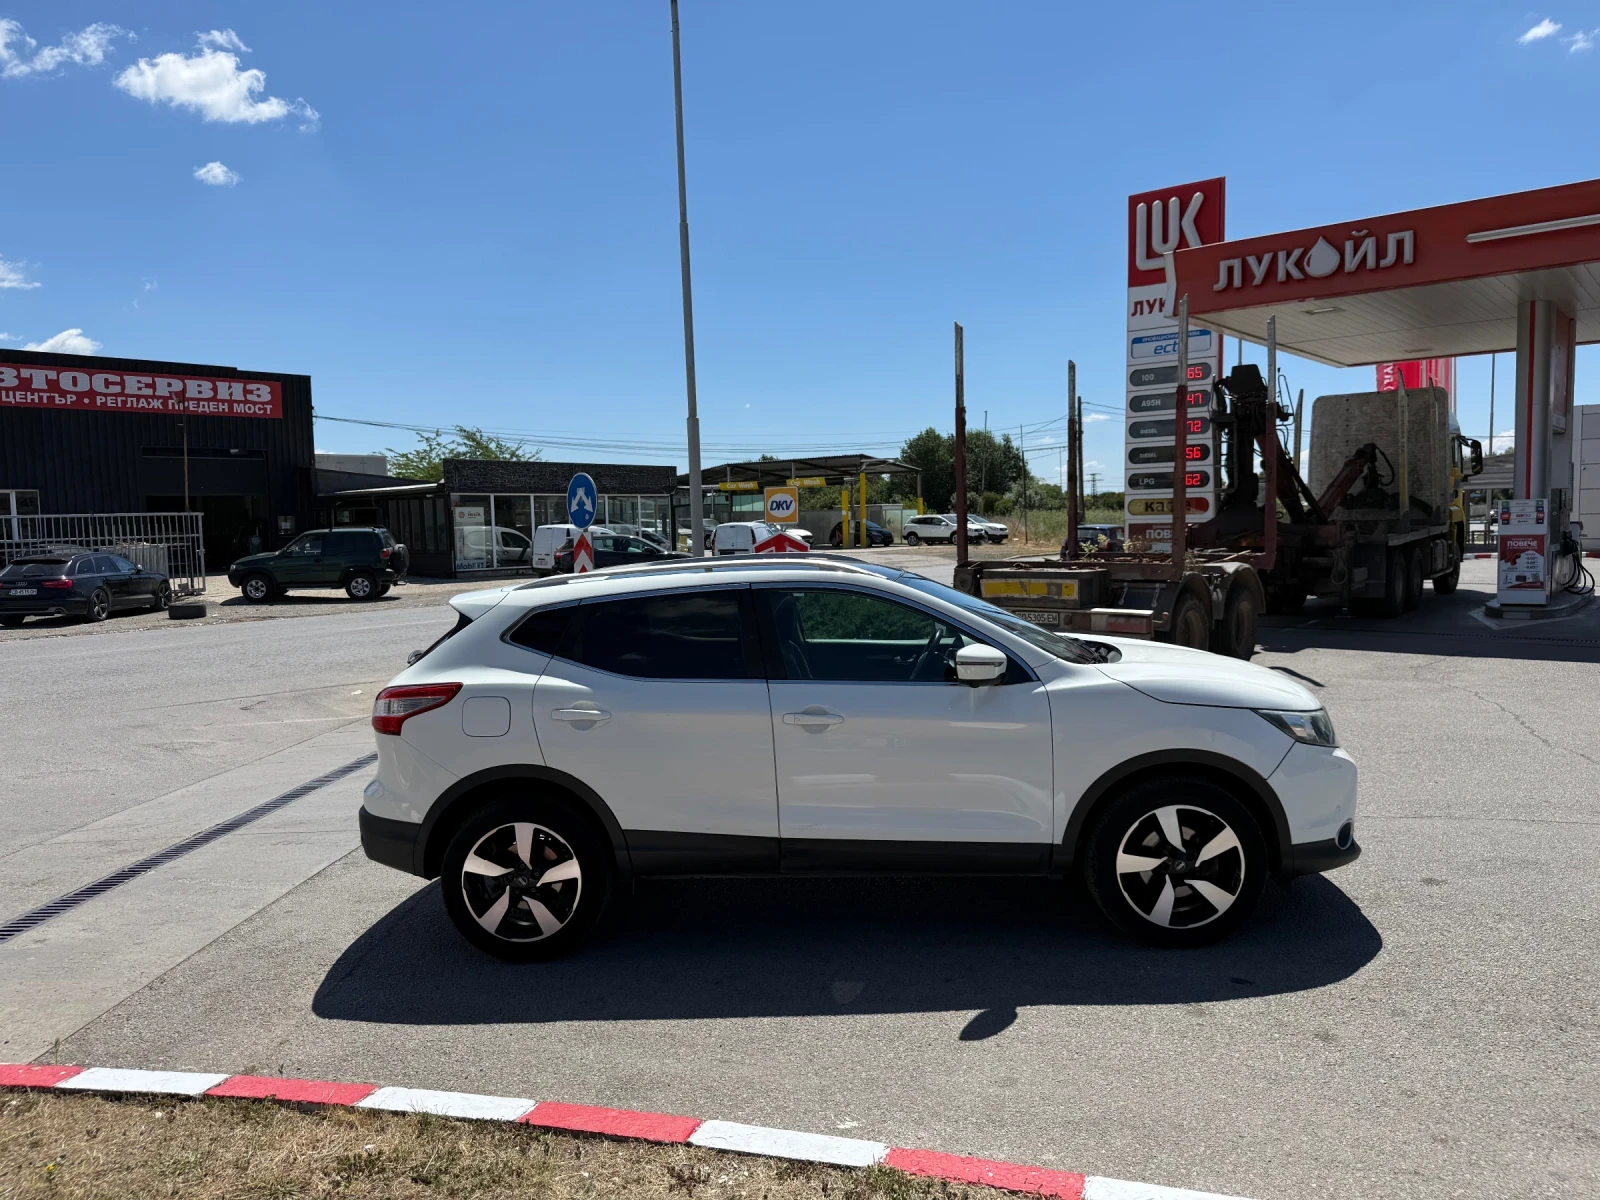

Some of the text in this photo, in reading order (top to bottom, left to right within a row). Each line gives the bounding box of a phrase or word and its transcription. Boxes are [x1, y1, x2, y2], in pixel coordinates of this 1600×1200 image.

[1131, 298, 1165, 317] ЛУК
[1154, 340, 1178, 355] ect
[1141, 374, 1154, 382] 100
[1, 390, 272, 415] ЦЕНТЪР РЕГЛАЖ ПРЕДЕН МОСТ
[1139, 477, 1155, 485] LPG
[770, 500, 793, 511] DKV
[1146, 529, 1172, 539] ПОВ
